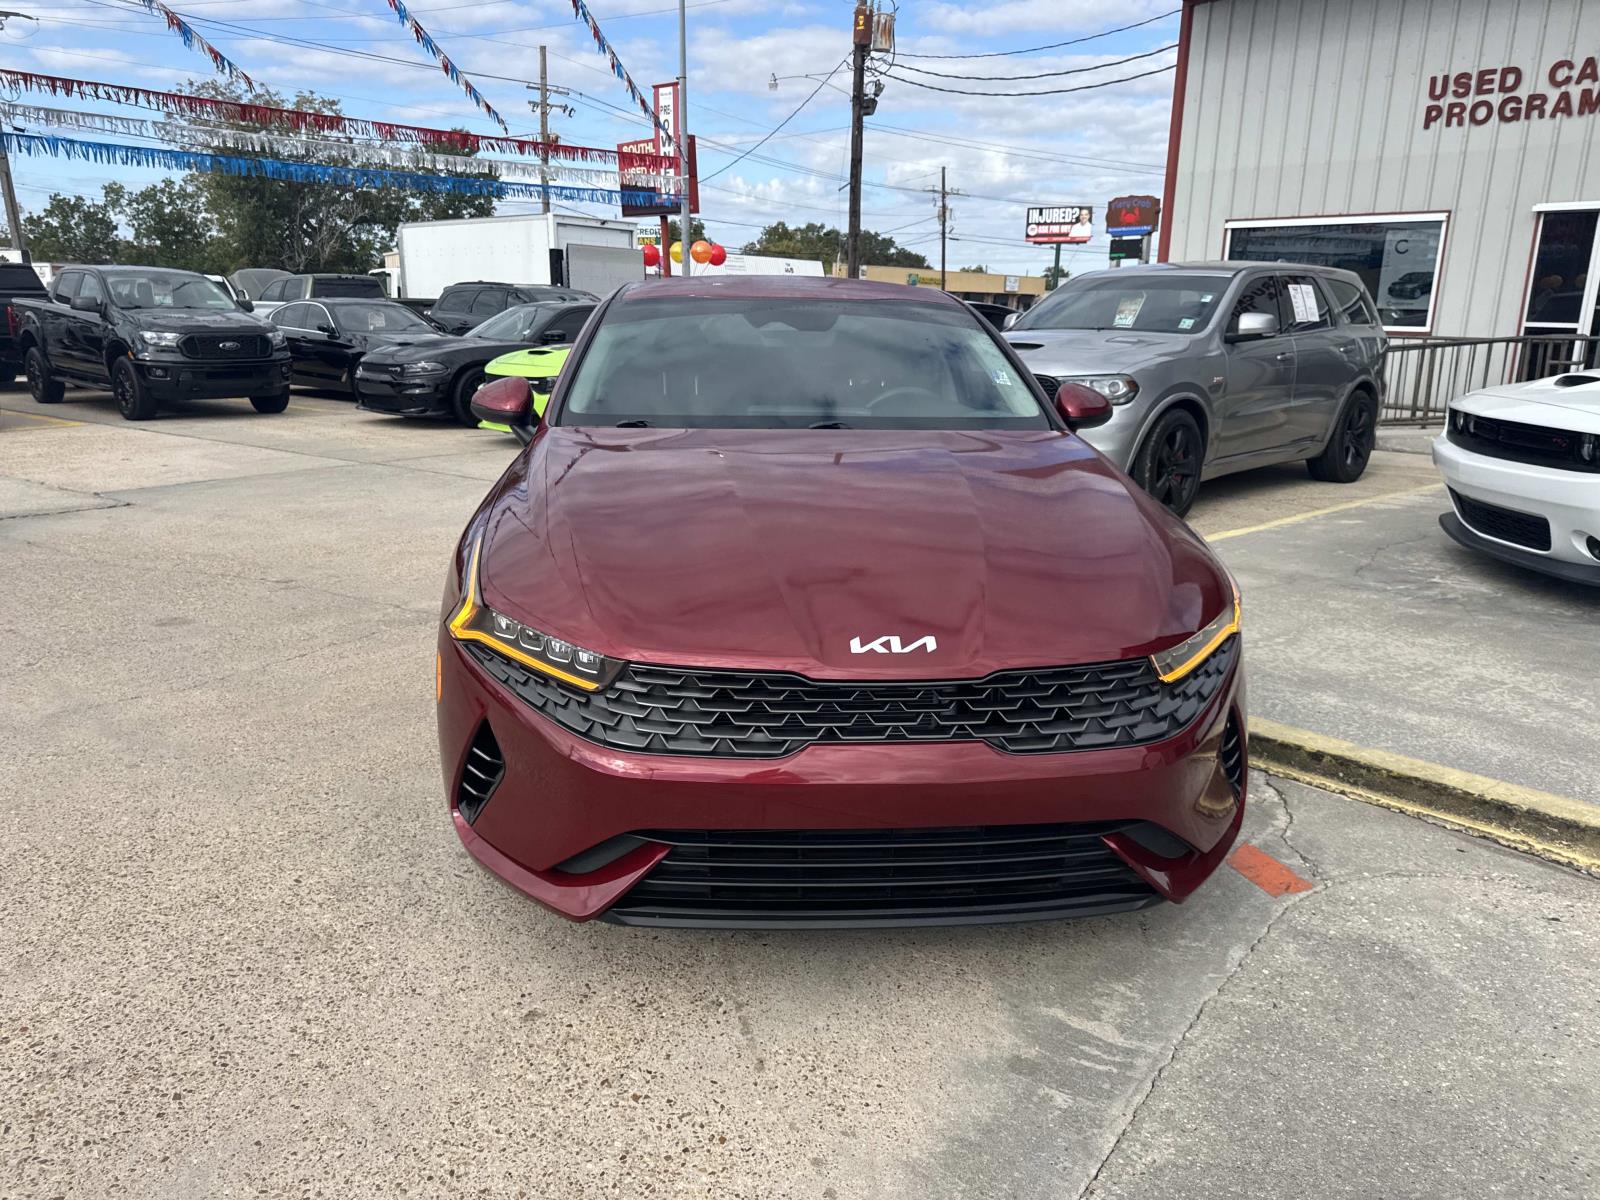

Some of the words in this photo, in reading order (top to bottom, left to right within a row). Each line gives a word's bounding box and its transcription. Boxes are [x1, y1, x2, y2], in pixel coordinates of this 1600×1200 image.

[1428, 66, 1522, 101] USED
[1548, 56, 1599, 88] CA
[1423, 88, 1600, 130] PROGRAM
[1028, 207, 1080, 224] INJURED?
